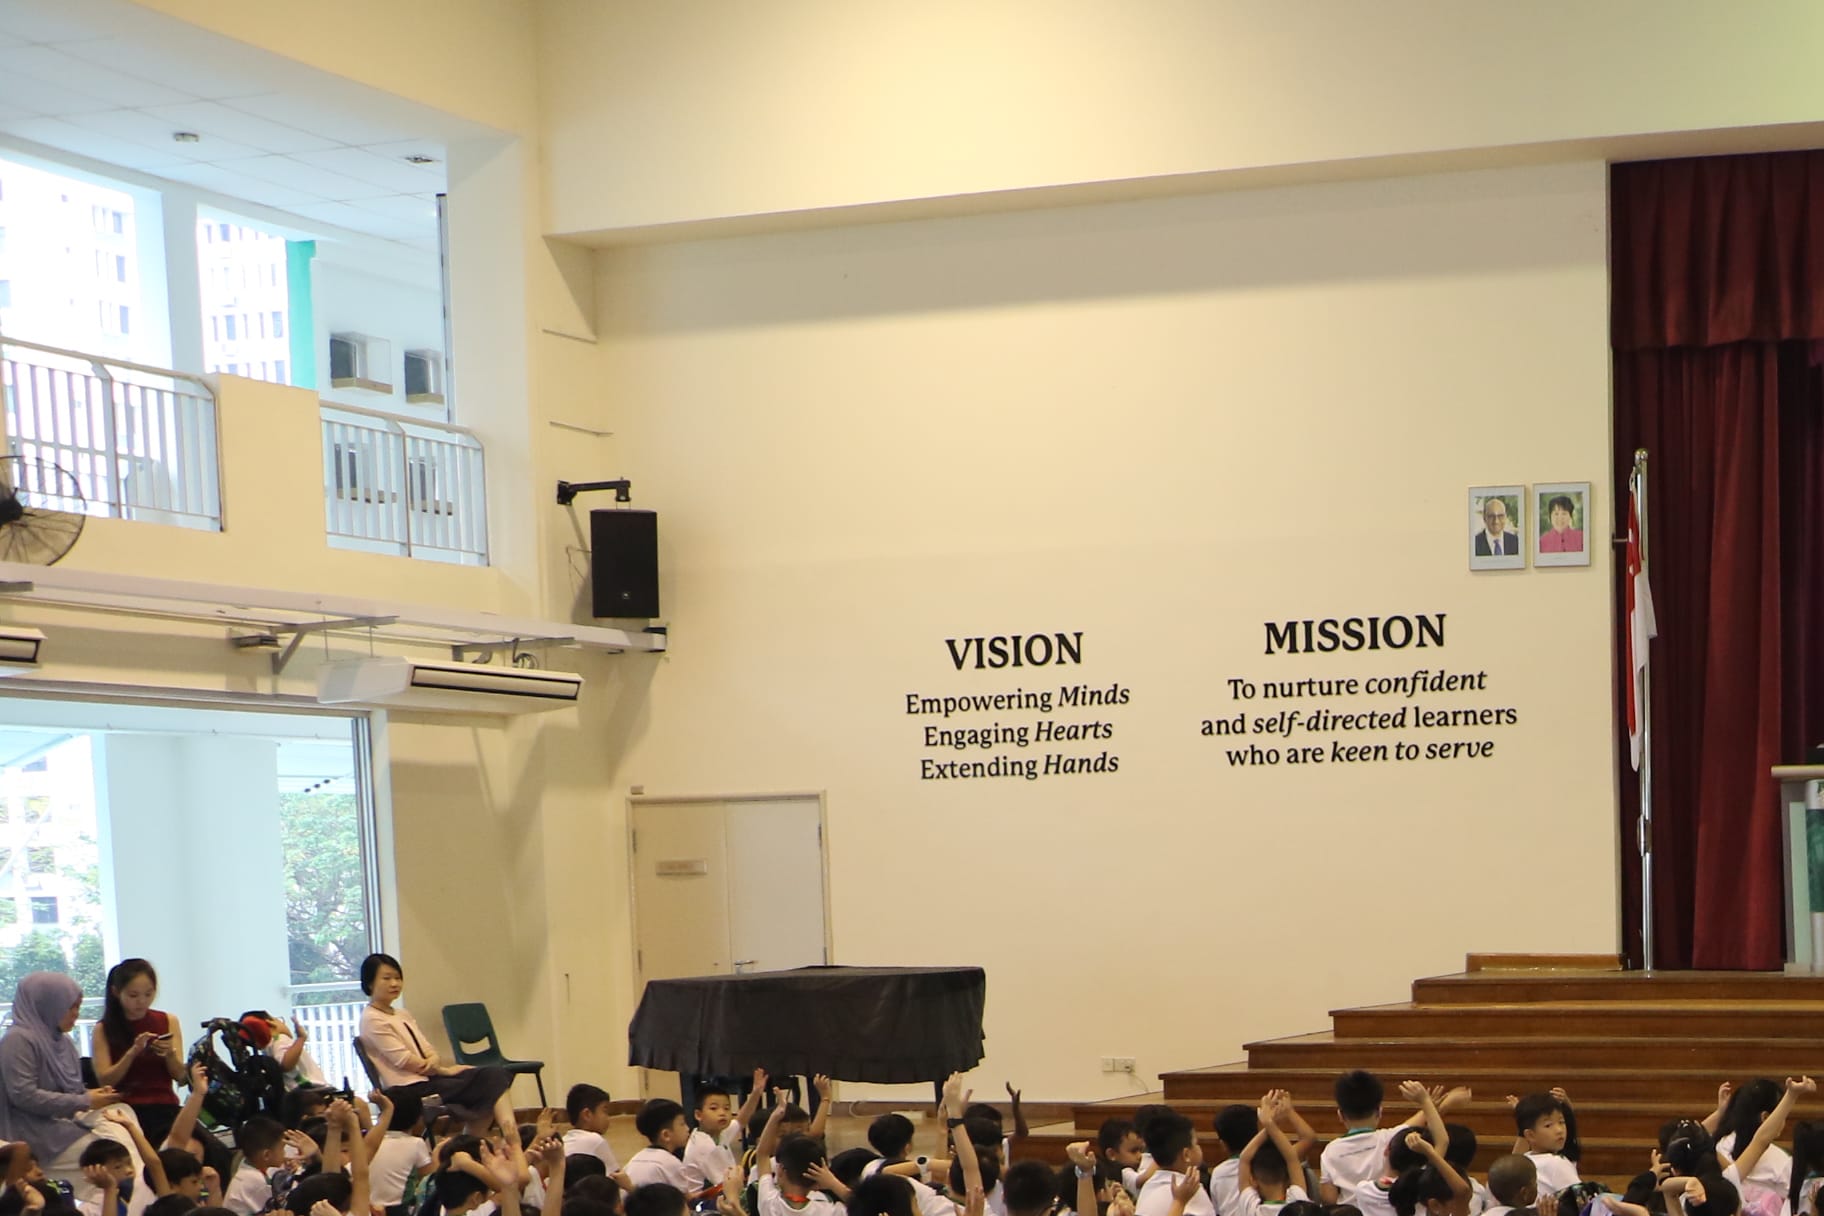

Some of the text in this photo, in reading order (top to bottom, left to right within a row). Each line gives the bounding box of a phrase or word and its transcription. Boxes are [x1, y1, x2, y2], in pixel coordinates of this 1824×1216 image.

[1265, 614, 1446, 654] MISSION
[946, 632, 1083, 670] VISION
[1228, 670, 1487, 699] To nurture confident
[907, 684, 1129, 717] Empowering Minds
[925, 721, 1112, 750] Engaging Hearts
[1202, 706, 1517, 737] and self-directed learners
[922, 752, 1118, 780] Extending Hands
[1226, 741, 1494, 766] who are keen to serve
